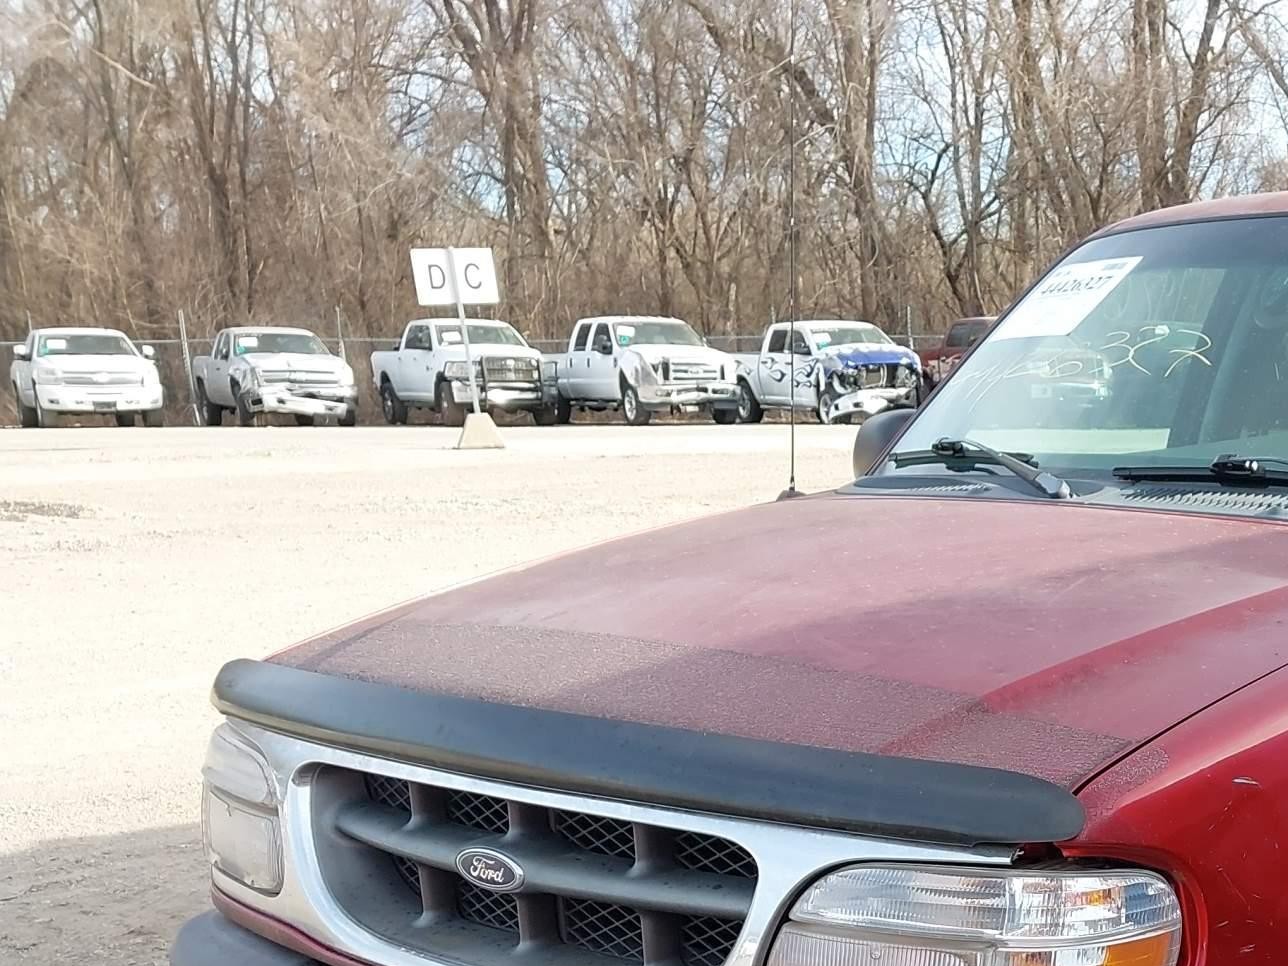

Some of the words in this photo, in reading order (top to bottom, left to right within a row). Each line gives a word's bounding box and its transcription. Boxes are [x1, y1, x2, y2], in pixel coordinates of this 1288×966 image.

[428, 264, 445, 289] D
[465, 263, 481, 289] C
[470, 856, 504, 882] Ford
